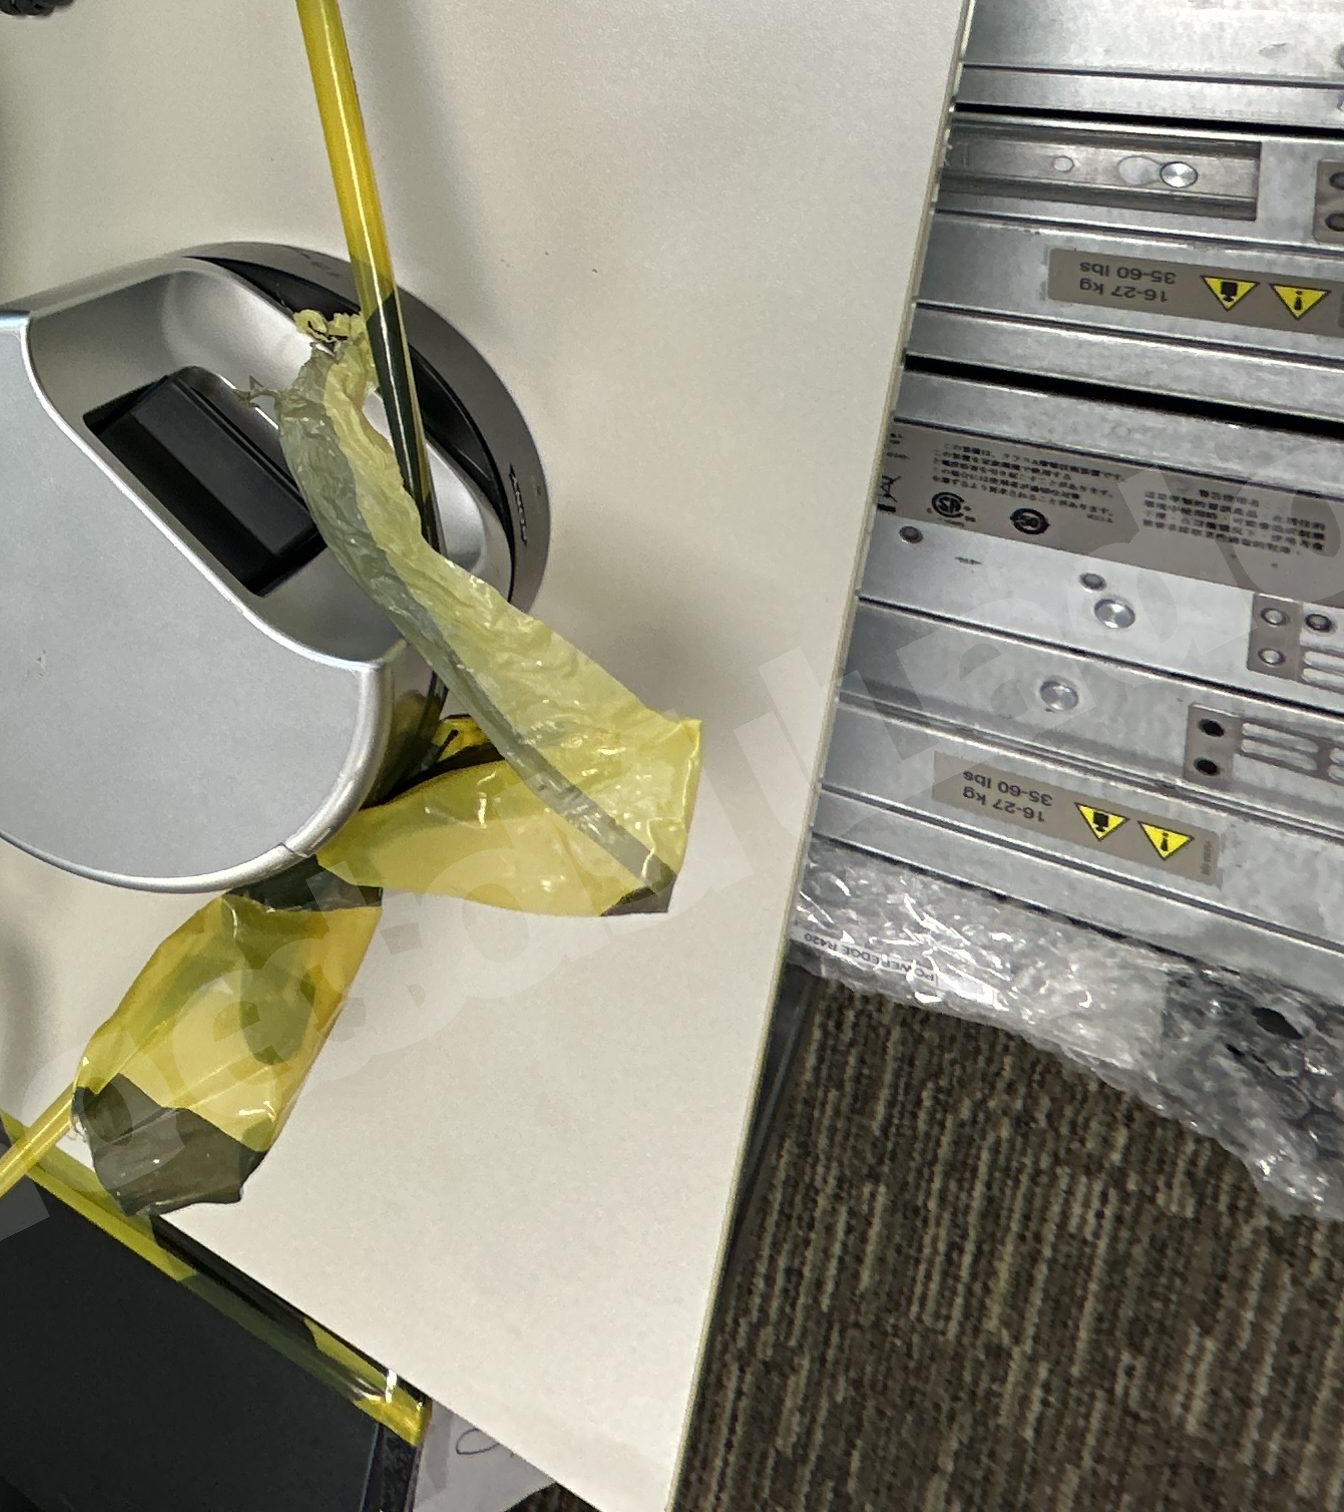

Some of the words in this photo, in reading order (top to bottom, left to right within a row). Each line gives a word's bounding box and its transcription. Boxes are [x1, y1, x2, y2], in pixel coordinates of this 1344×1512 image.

[1080, 262, 1110, 277] lbs
[1116, 266, 1176, 284] 35-60
[1080, 278, 1104, 295] kg
[1112, 286, 1168, 302] 16-27
[963, 770, 991, 788] lbs
[962, 786, 986, 806] kg
[998, 781, 1052, 806] 35-60
[992, 798, 1044, 822] 16-27
